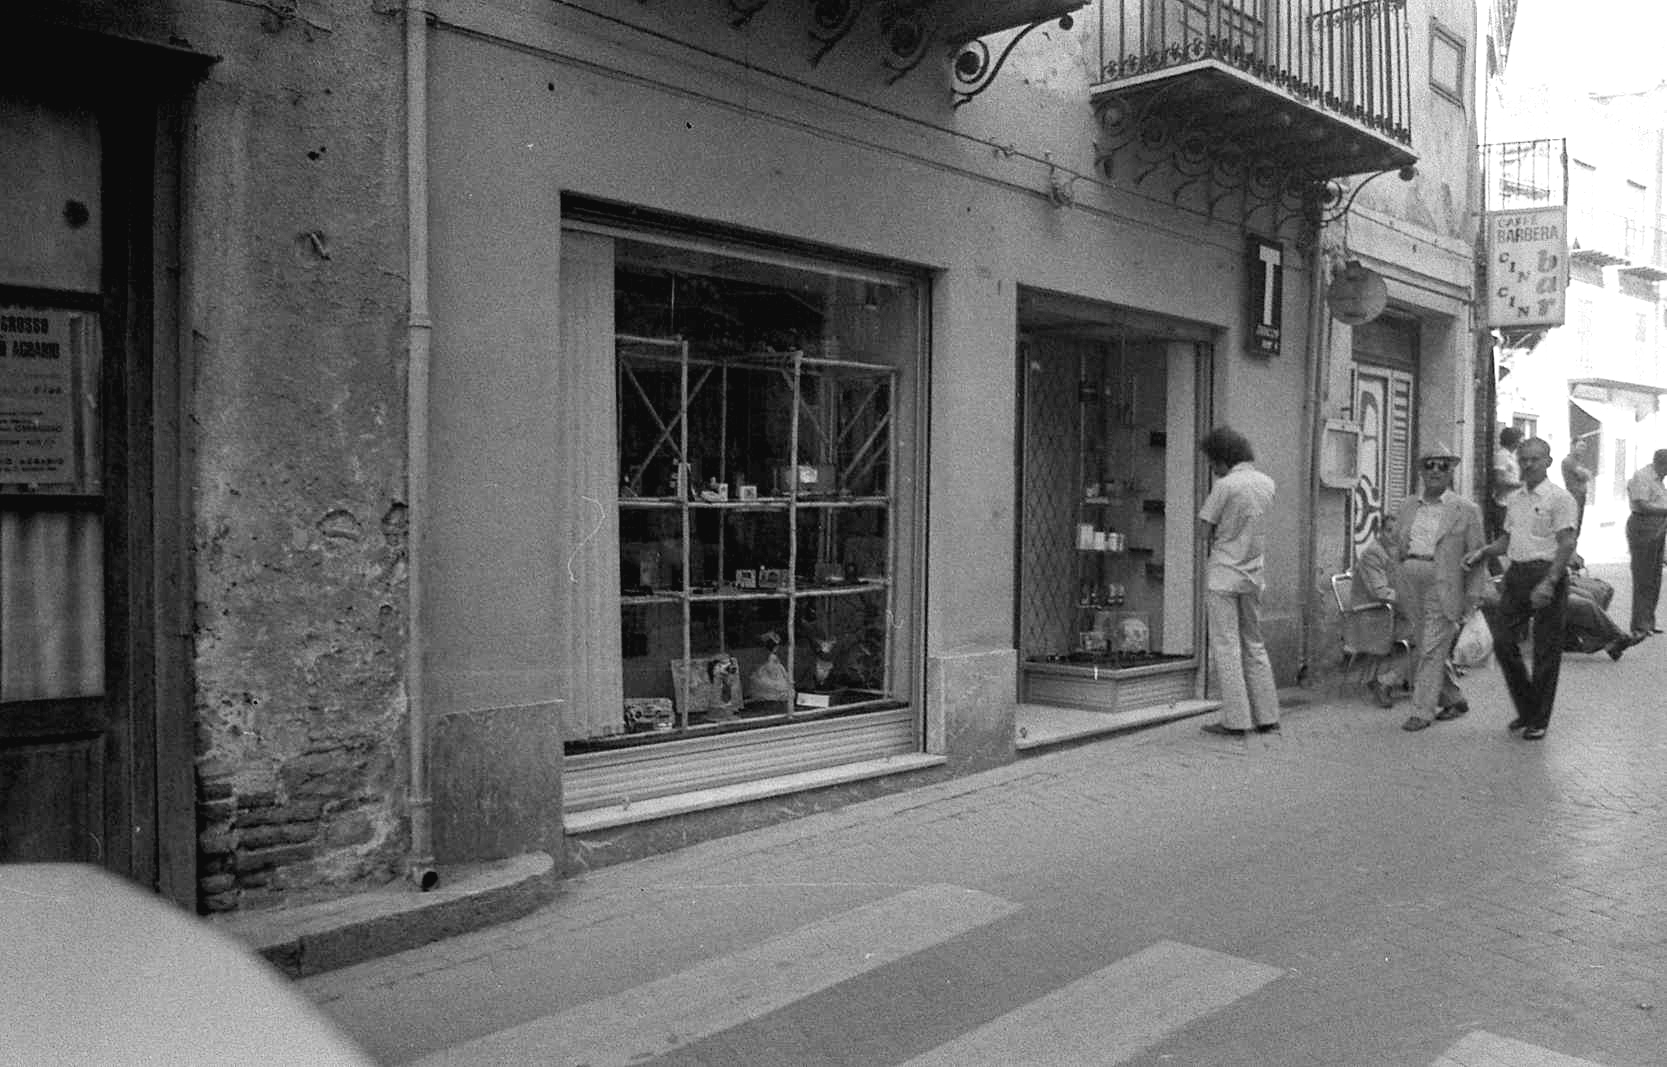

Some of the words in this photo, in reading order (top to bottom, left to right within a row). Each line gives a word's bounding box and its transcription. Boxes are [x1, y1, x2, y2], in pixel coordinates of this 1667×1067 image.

[1497, 225, 1559, 243] BARBERA
[1499, 252, 1531, 283] CIN
[1259, 243, 1281, 326] T
[1497, 287, 1530, 318] CIN
